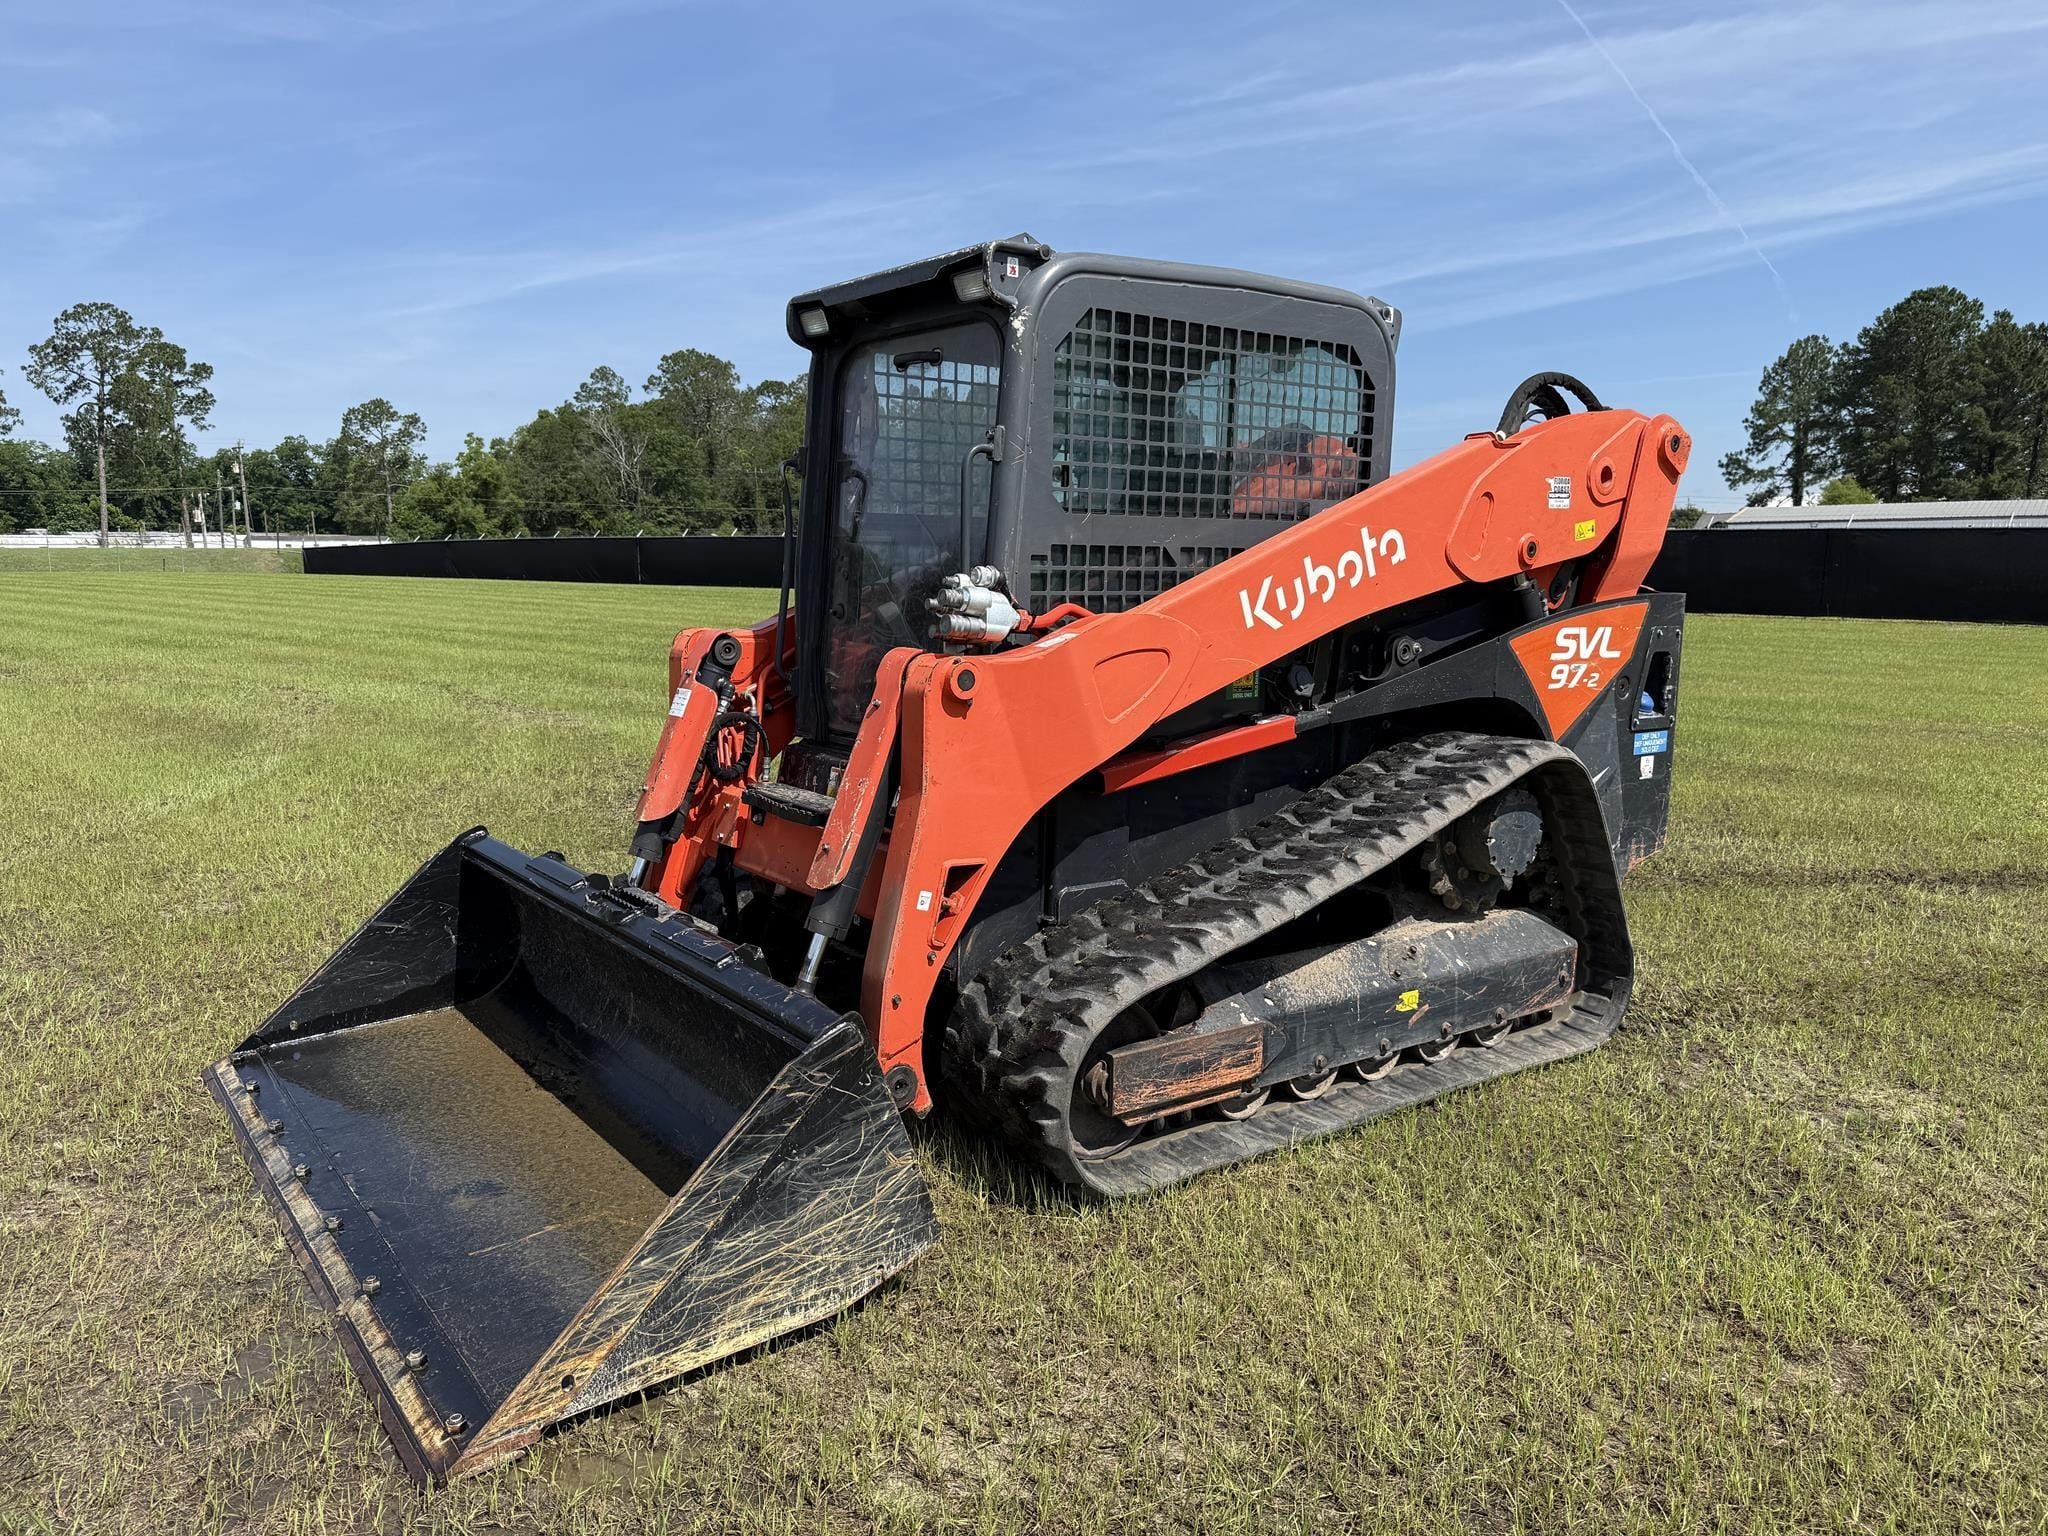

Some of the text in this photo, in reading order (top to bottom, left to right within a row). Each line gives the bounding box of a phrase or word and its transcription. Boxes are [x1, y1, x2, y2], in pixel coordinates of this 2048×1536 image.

[1239, 526, 1406, 630] Kubota
[1550, 626, 1621, 660] SVL
[1548, 664, 1600, 689] 97-2
